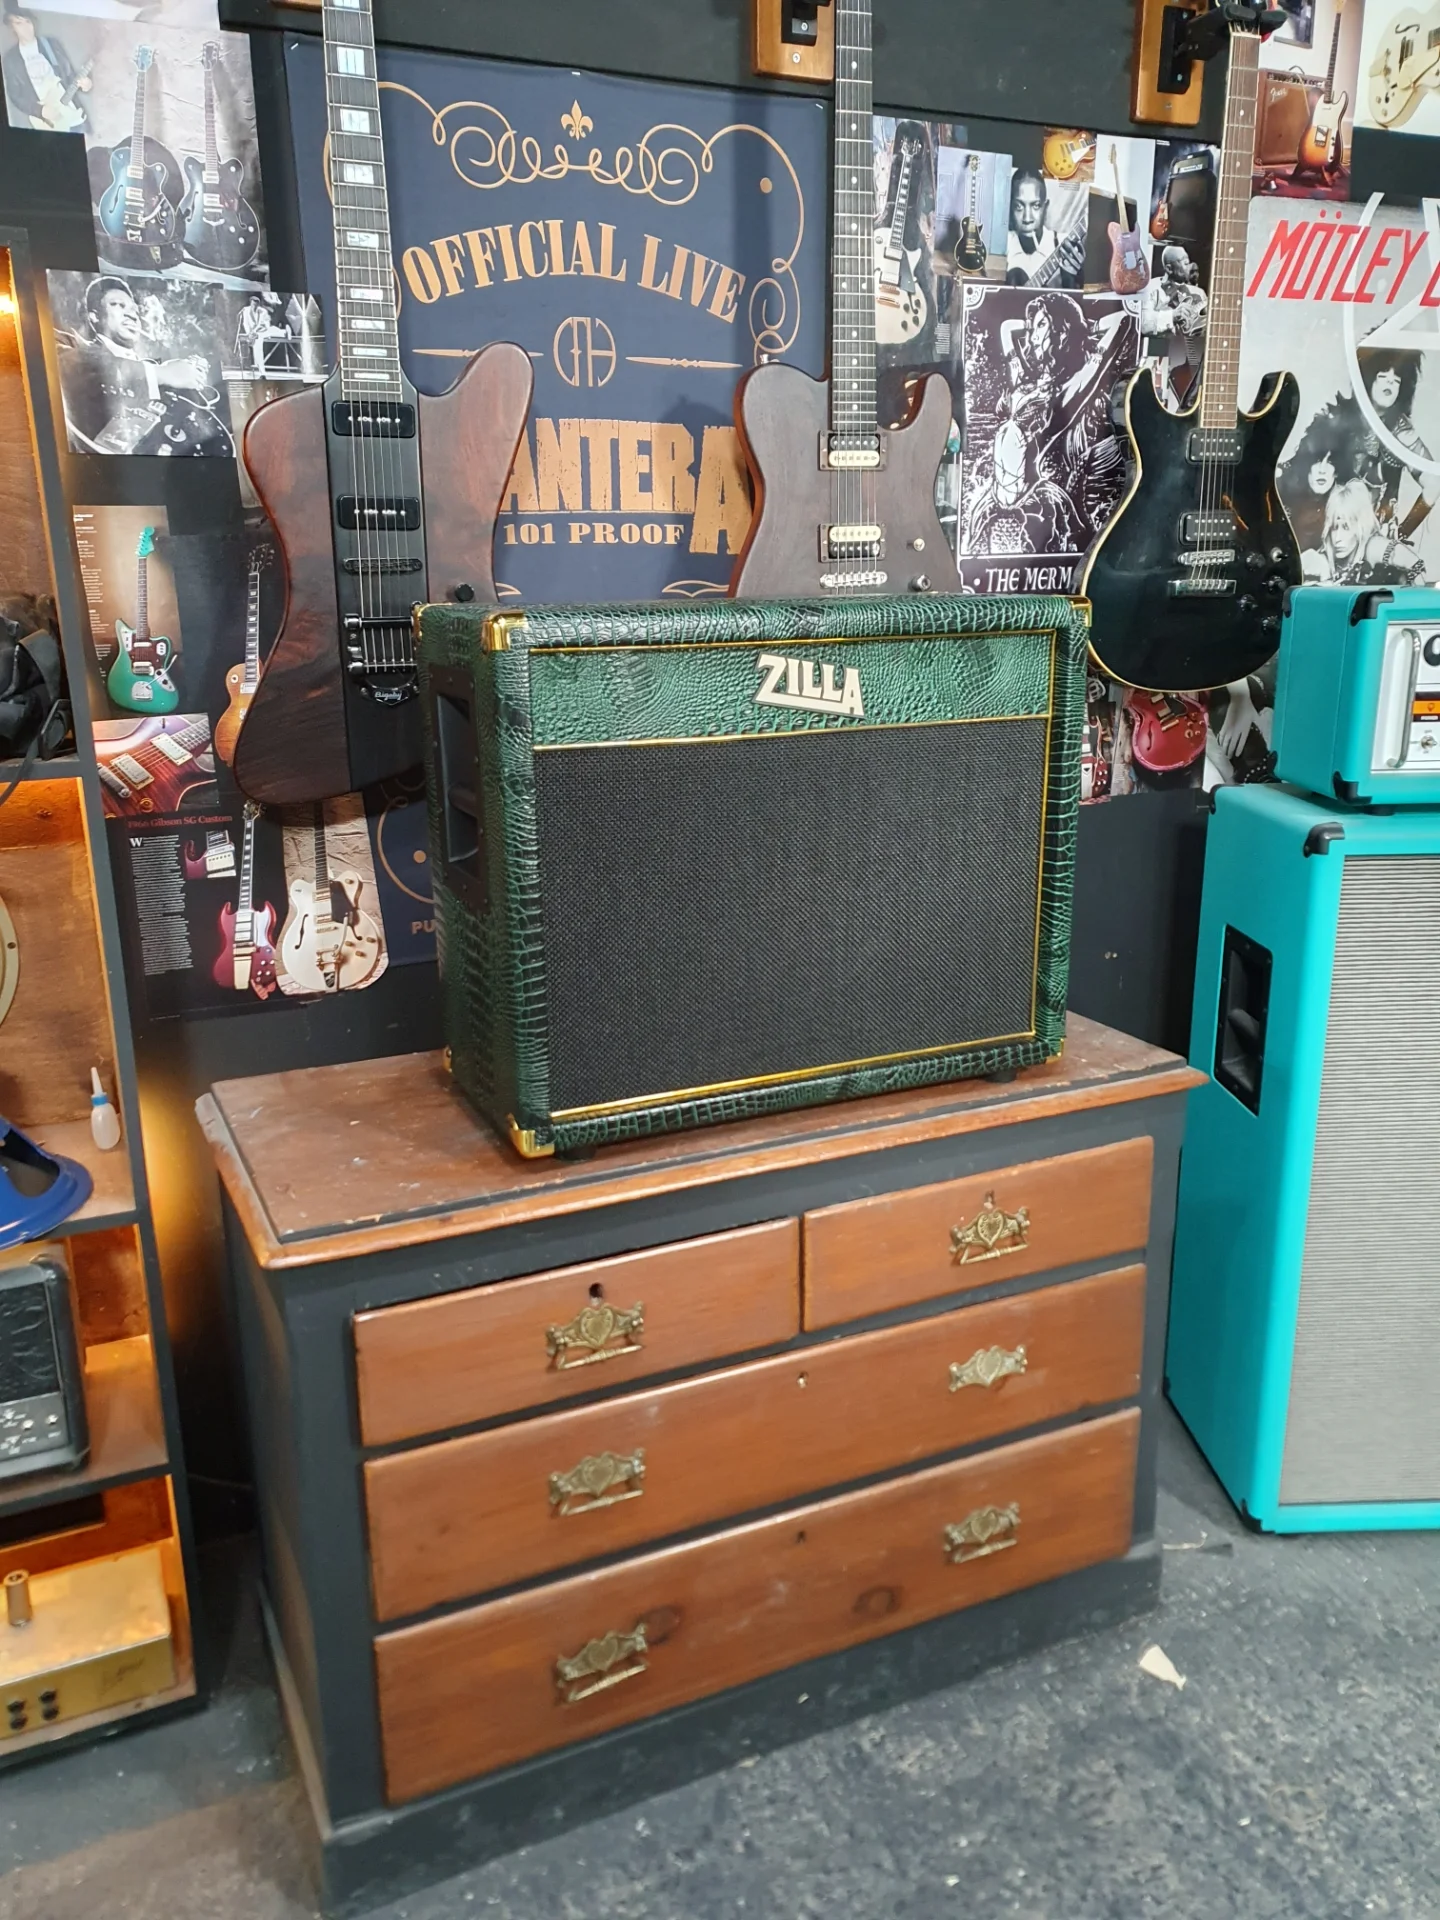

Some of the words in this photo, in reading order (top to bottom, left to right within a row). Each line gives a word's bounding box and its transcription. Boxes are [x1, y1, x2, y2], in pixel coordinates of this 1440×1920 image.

[402, 219, 627, 303] OFFICIAL
[637, 233, 746, 324] LIVE
[1246, 209, 1429, 304] MÖTLEY
[500, 418, 757, 554] ANTERA
[503, 523, 556, 545] 101
[568, 522, 685, 545] PROOF
[985, 567, 1020, 593] THE
[754, 653, 865, 717] ZILLA
[198, 815, 233, 824] Custom
